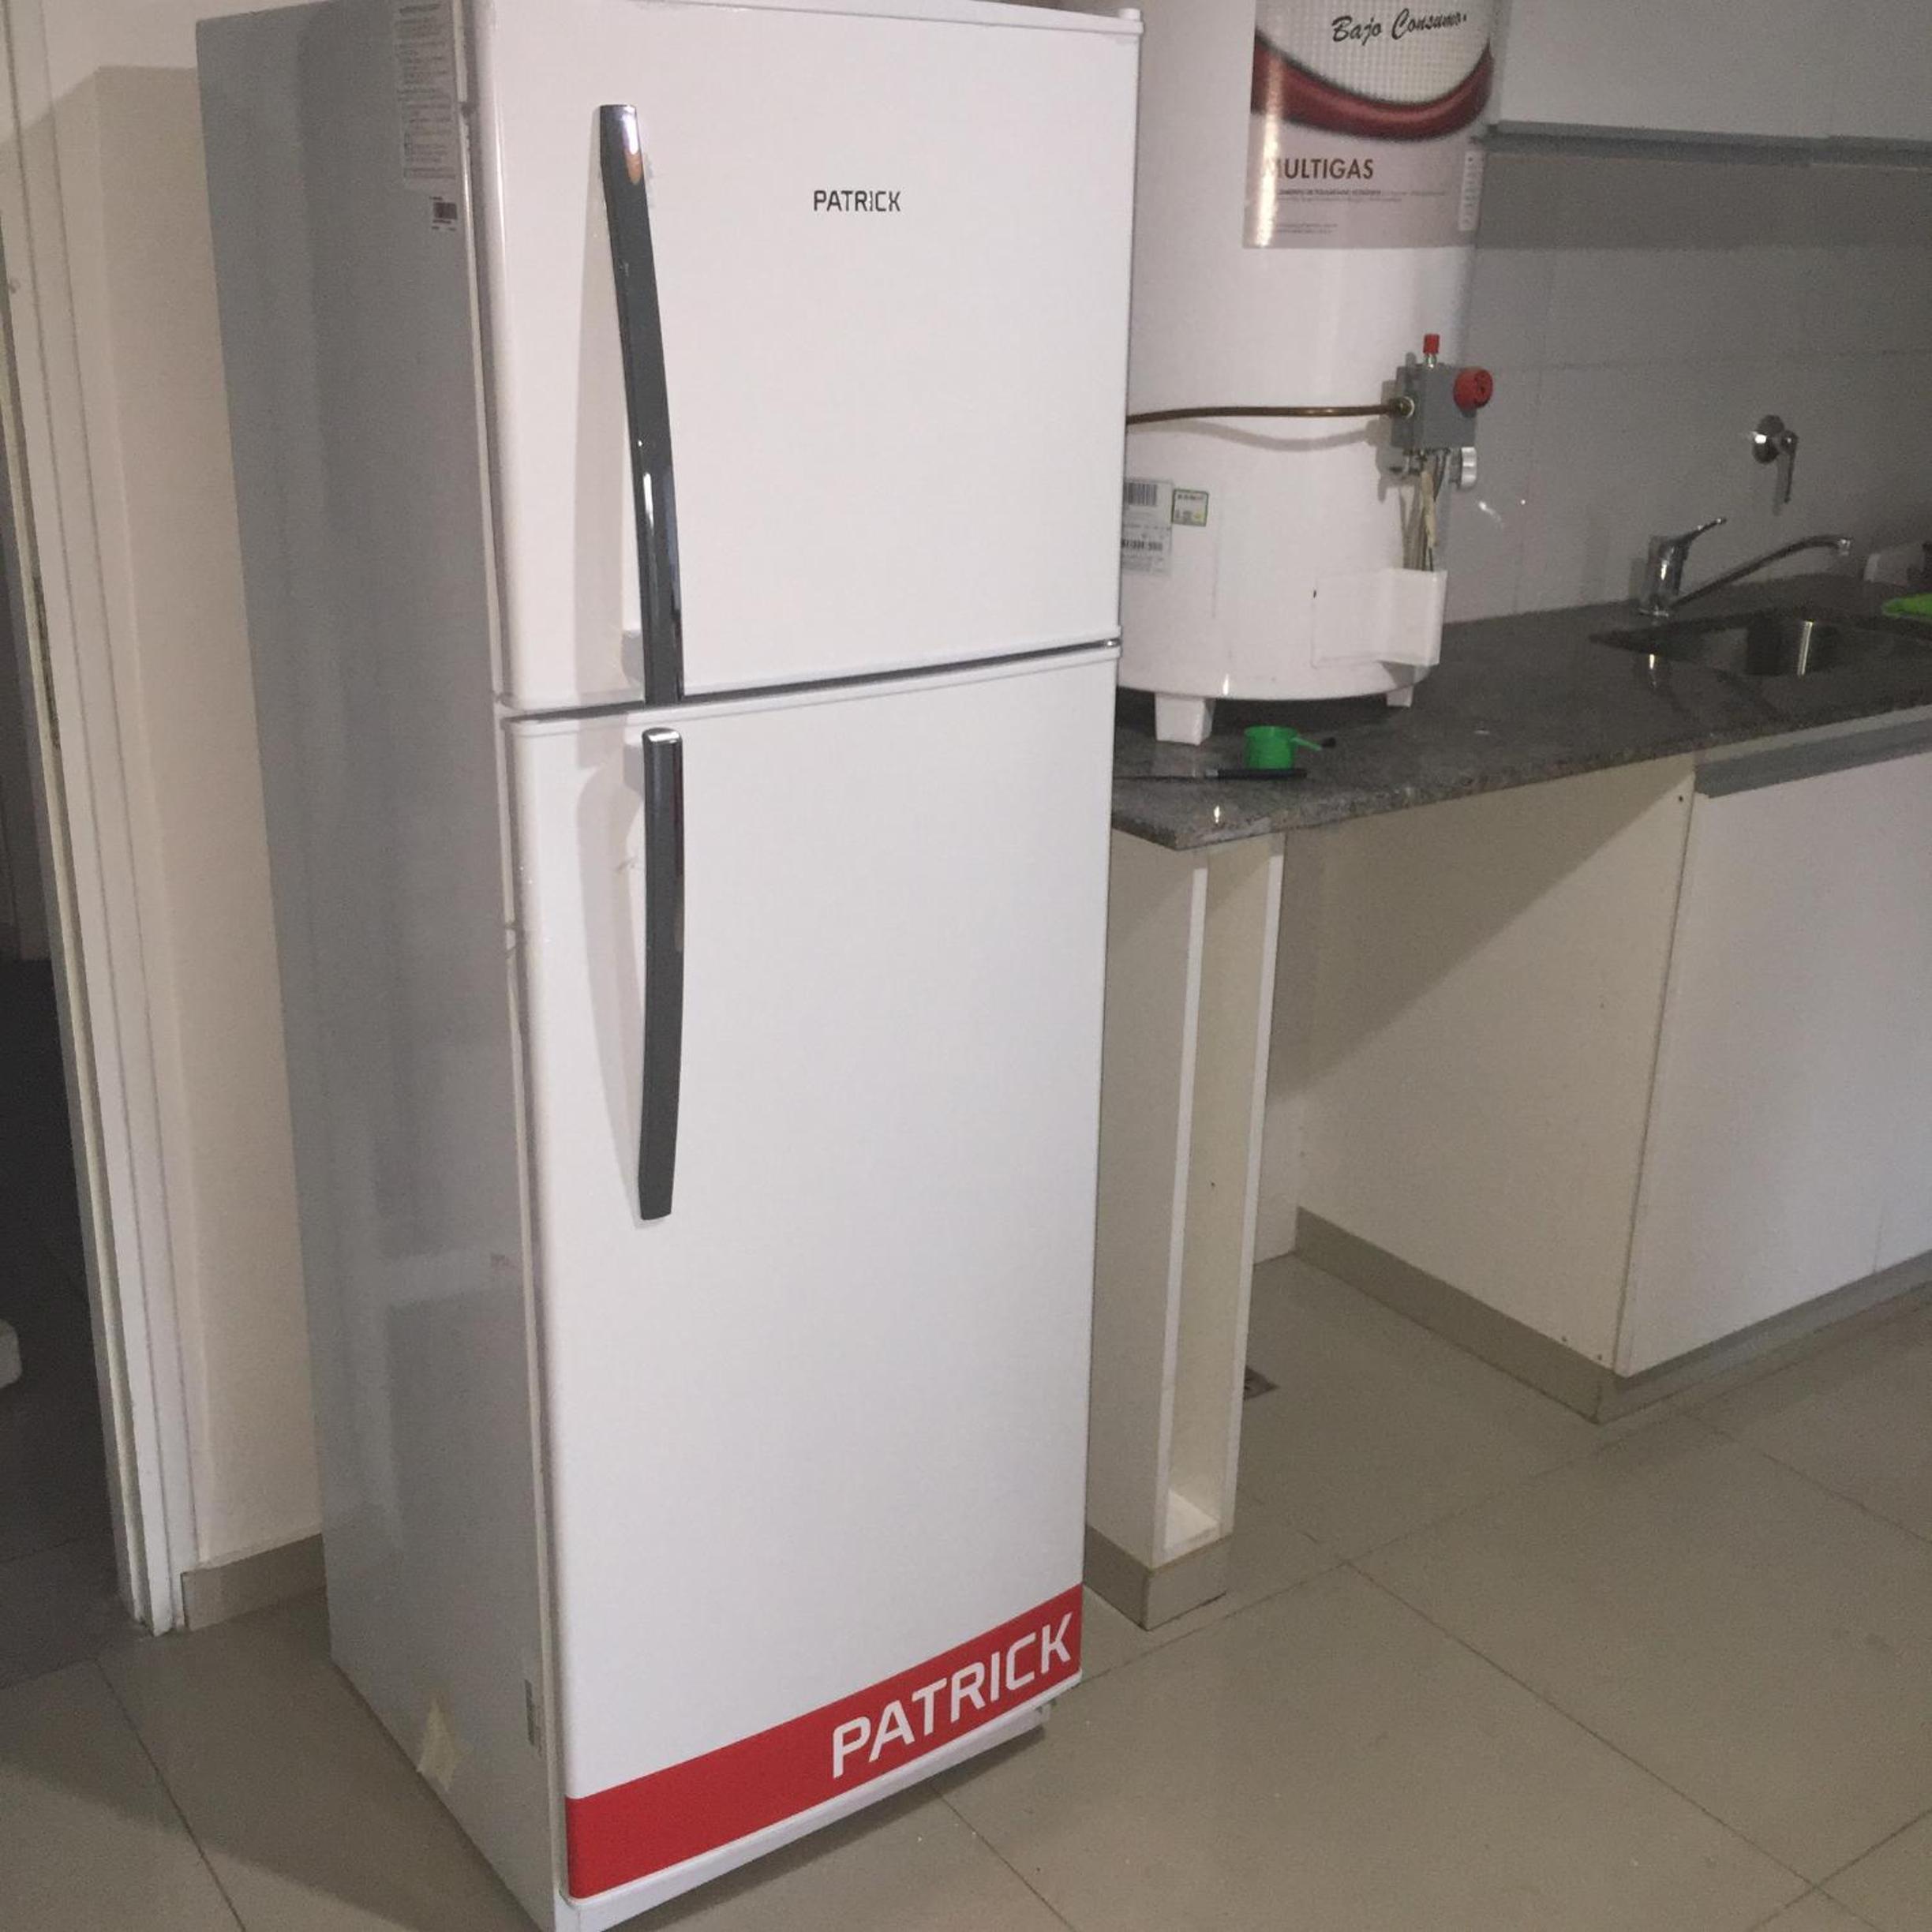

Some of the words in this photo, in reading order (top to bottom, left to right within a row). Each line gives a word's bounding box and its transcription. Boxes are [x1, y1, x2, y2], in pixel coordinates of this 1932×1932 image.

[1331, 15, 1382, 46] Bajo
[1276, 158, 1374, 179] ULTIGAS
[814, 190, 901, 212] PATRICK
[832, 1612, 1073, 1779] PATRICK
